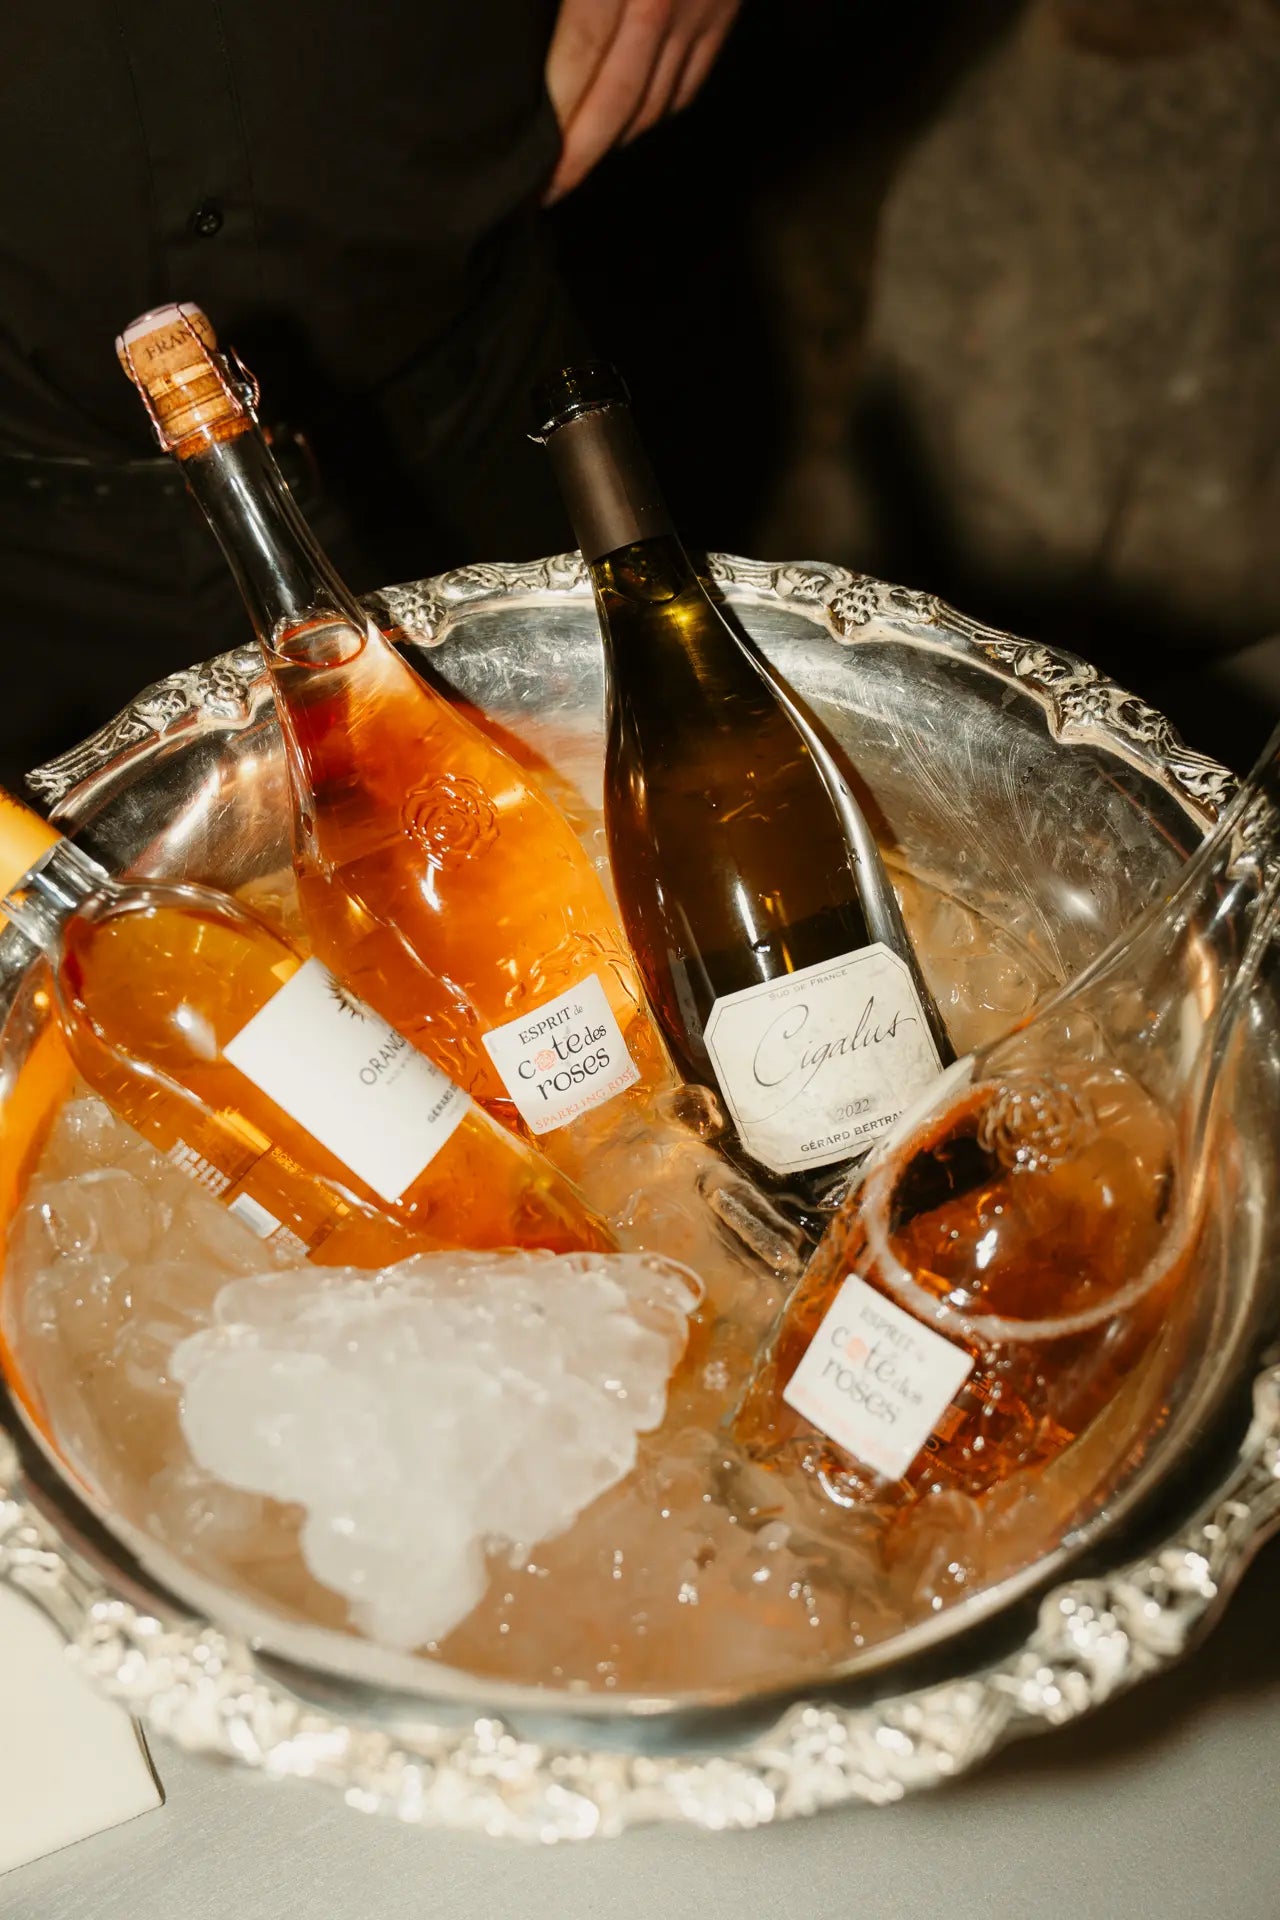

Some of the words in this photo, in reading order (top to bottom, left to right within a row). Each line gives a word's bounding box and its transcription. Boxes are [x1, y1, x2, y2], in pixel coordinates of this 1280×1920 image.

[794, 983, 808, 993] DE
[810, 970, 849, 988] FRANCE
[518, 1007, 571, 1045] ESPRIT
[584, 1024, 607, 1047] des
[747, 996, 917, 1100] Cigalus
[536, 1047, 611, 1101] roses
[836, 1097, 870, 1122] 2022
[800, 1130, 851, 1153] GÉRARD
[854, 1109, 905, 1137] BERTRA
